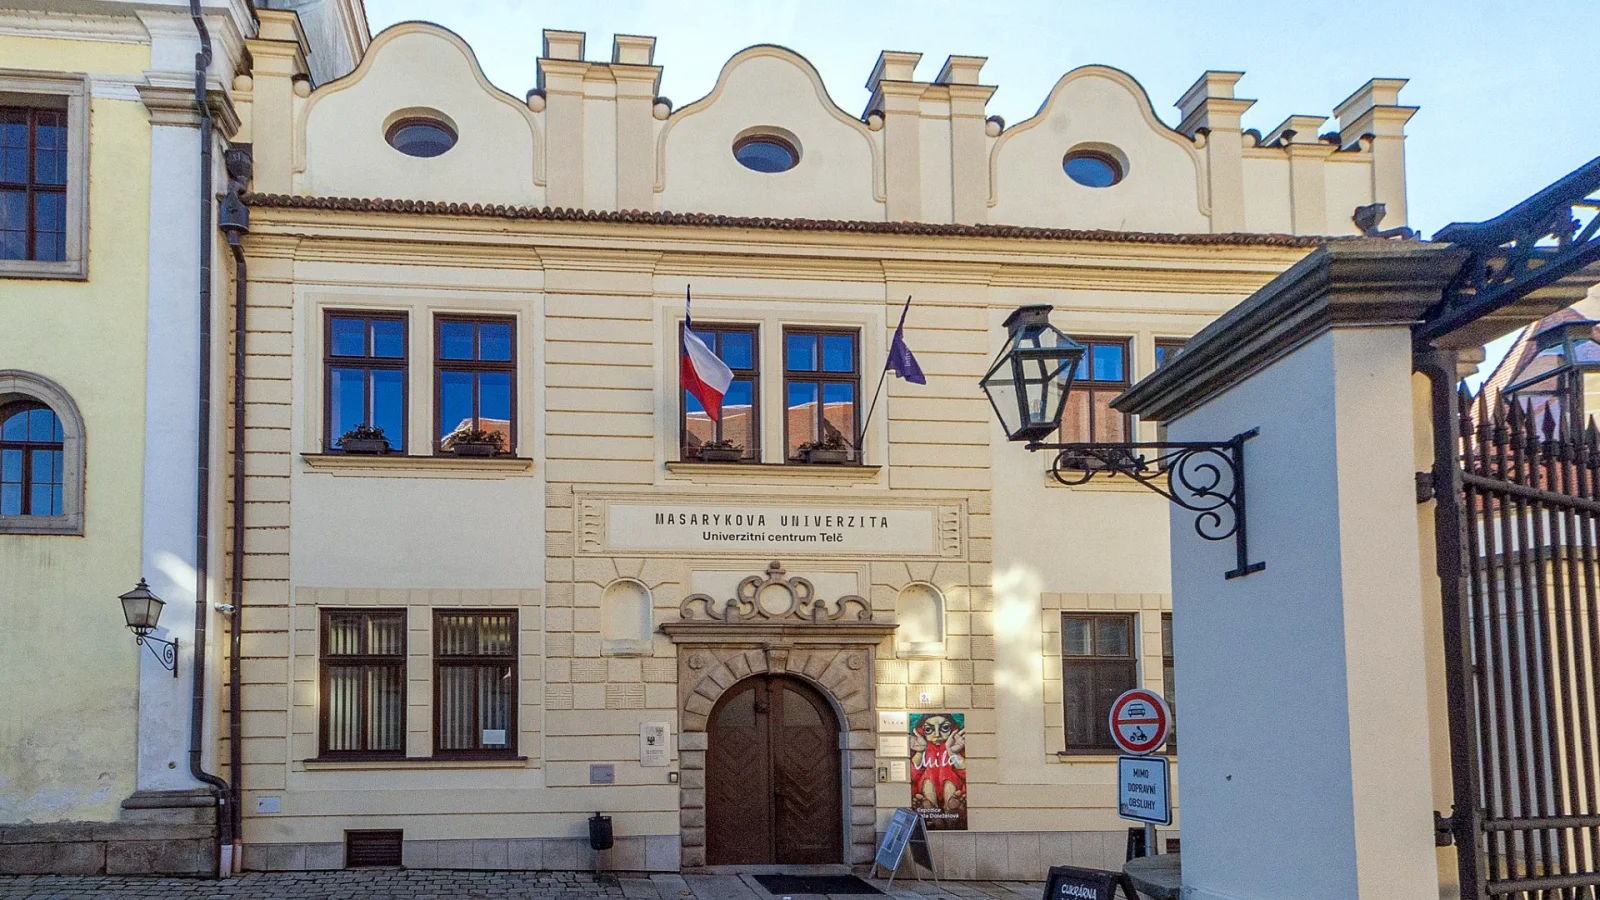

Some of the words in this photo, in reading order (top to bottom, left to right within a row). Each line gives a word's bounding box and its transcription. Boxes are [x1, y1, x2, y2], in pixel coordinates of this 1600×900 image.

[655, 513, 766, 526] MASARYKOVA
[780, 515, 888, 528] UNIVERZITA
[702, 531, 766, 542] Univerzitní
[768, 533, 817, 542] centrum
[819, 532, 844, 543] Telč
[1133, 768, 1149, 778] MIMO
[1128, 783, 1156, 794] DOPRAVNÍ
[1128, 798, 1156, 810] OBSLUHY
